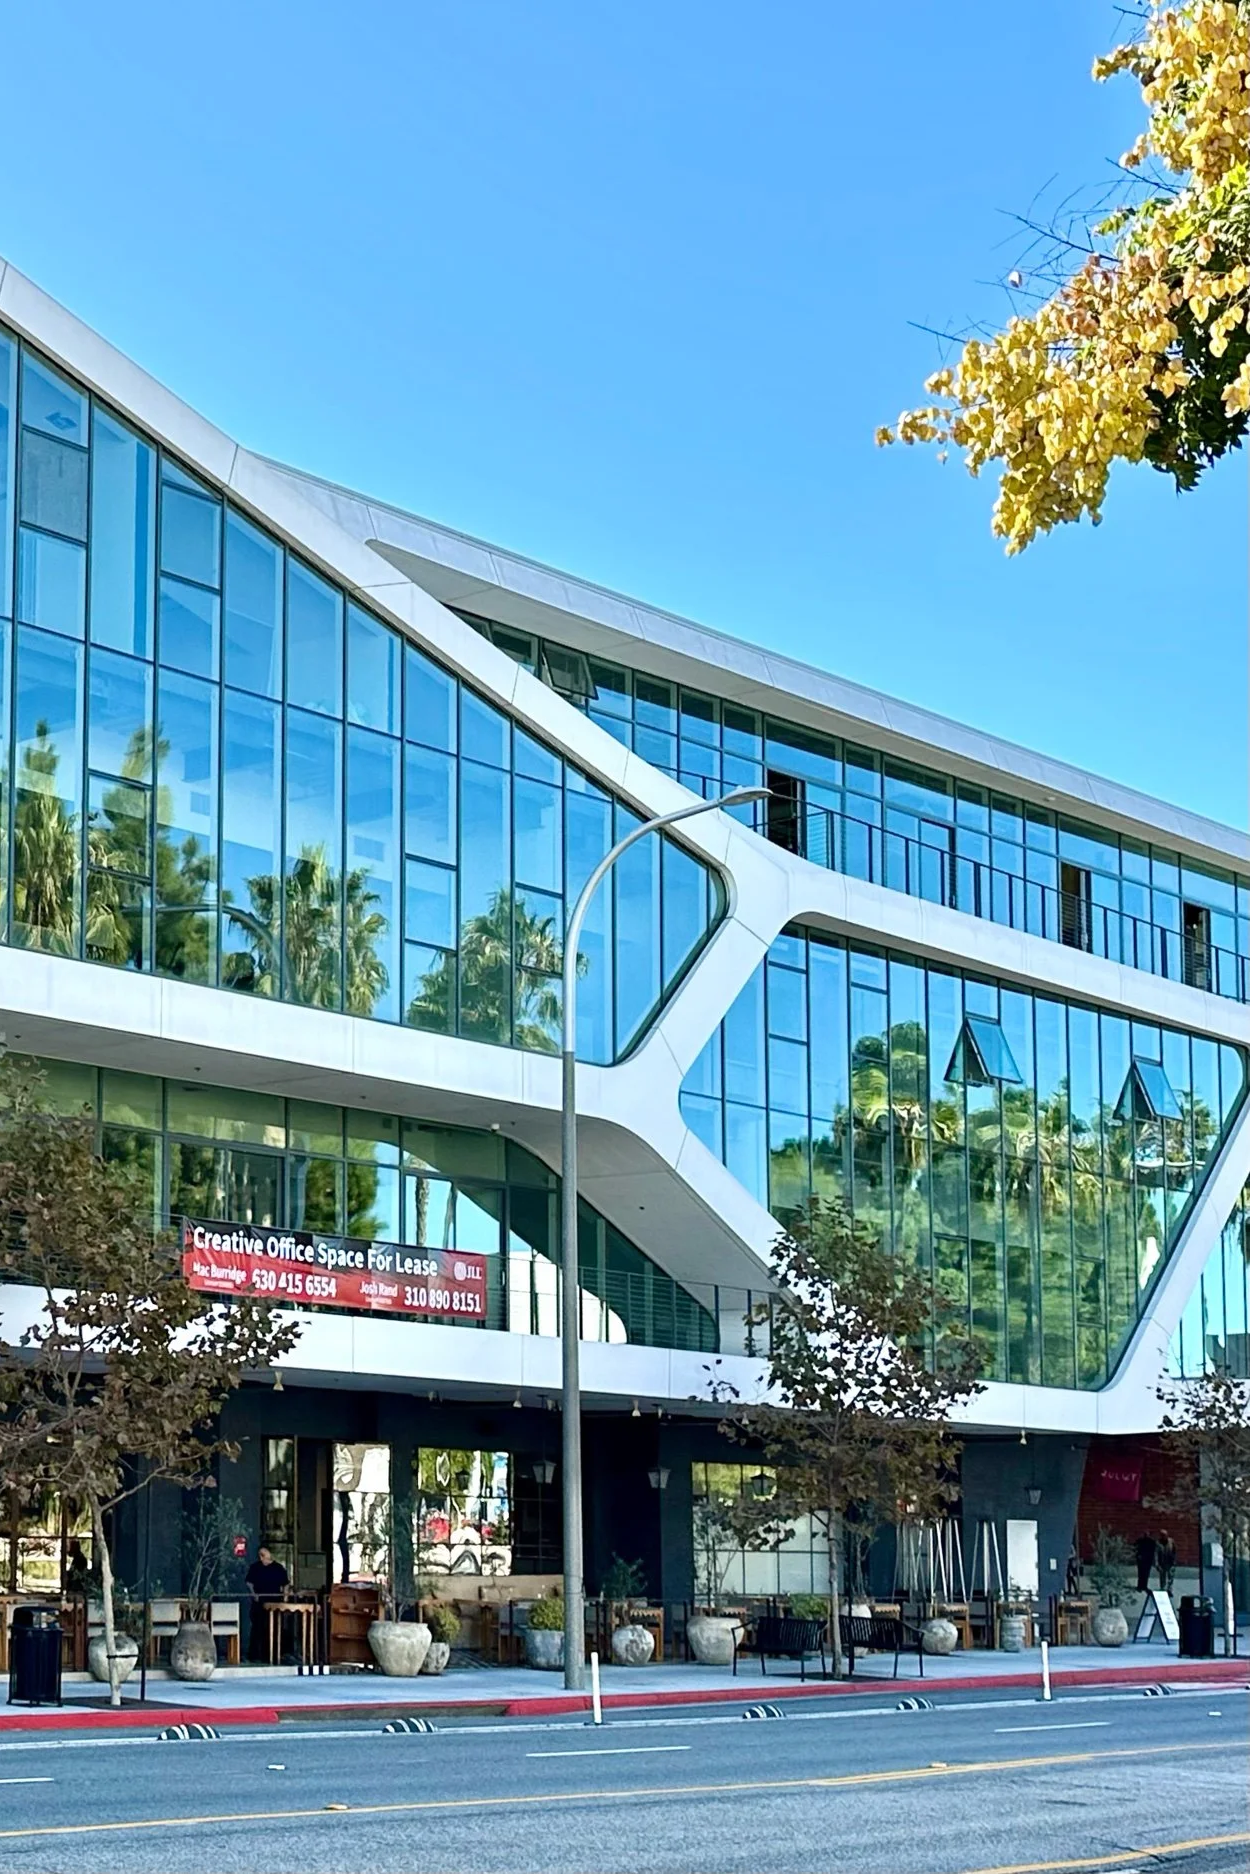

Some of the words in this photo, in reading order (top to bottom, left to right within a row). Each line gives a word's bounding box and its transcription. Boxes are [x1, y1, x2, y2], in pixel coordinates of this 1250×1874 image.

[193, 1226, 264, 1256] Creative
[266, 1236, 315, 1262] Office
[317, 1242, 364, 1270] Space
[367, 1248, 393, 1271] For
[395, 1252, 438, 1277] Lease
[193, 1261, 209, 1277] Mac
[210, 1263, 247, 1285] Burridge
[252, 1268, 277, 1291] 630
[278, 1272, 303, 1294] 415
[305, 1275, 337, 1298] 6554
[466, 1266, 482, 1280] JLL
[360, 1281, 378, 1295] Josh
[404, 1286, 427, 1307] 310
[429, 1289, 450, 1309] 890
[452, 1292, 482, 1313] 8151
